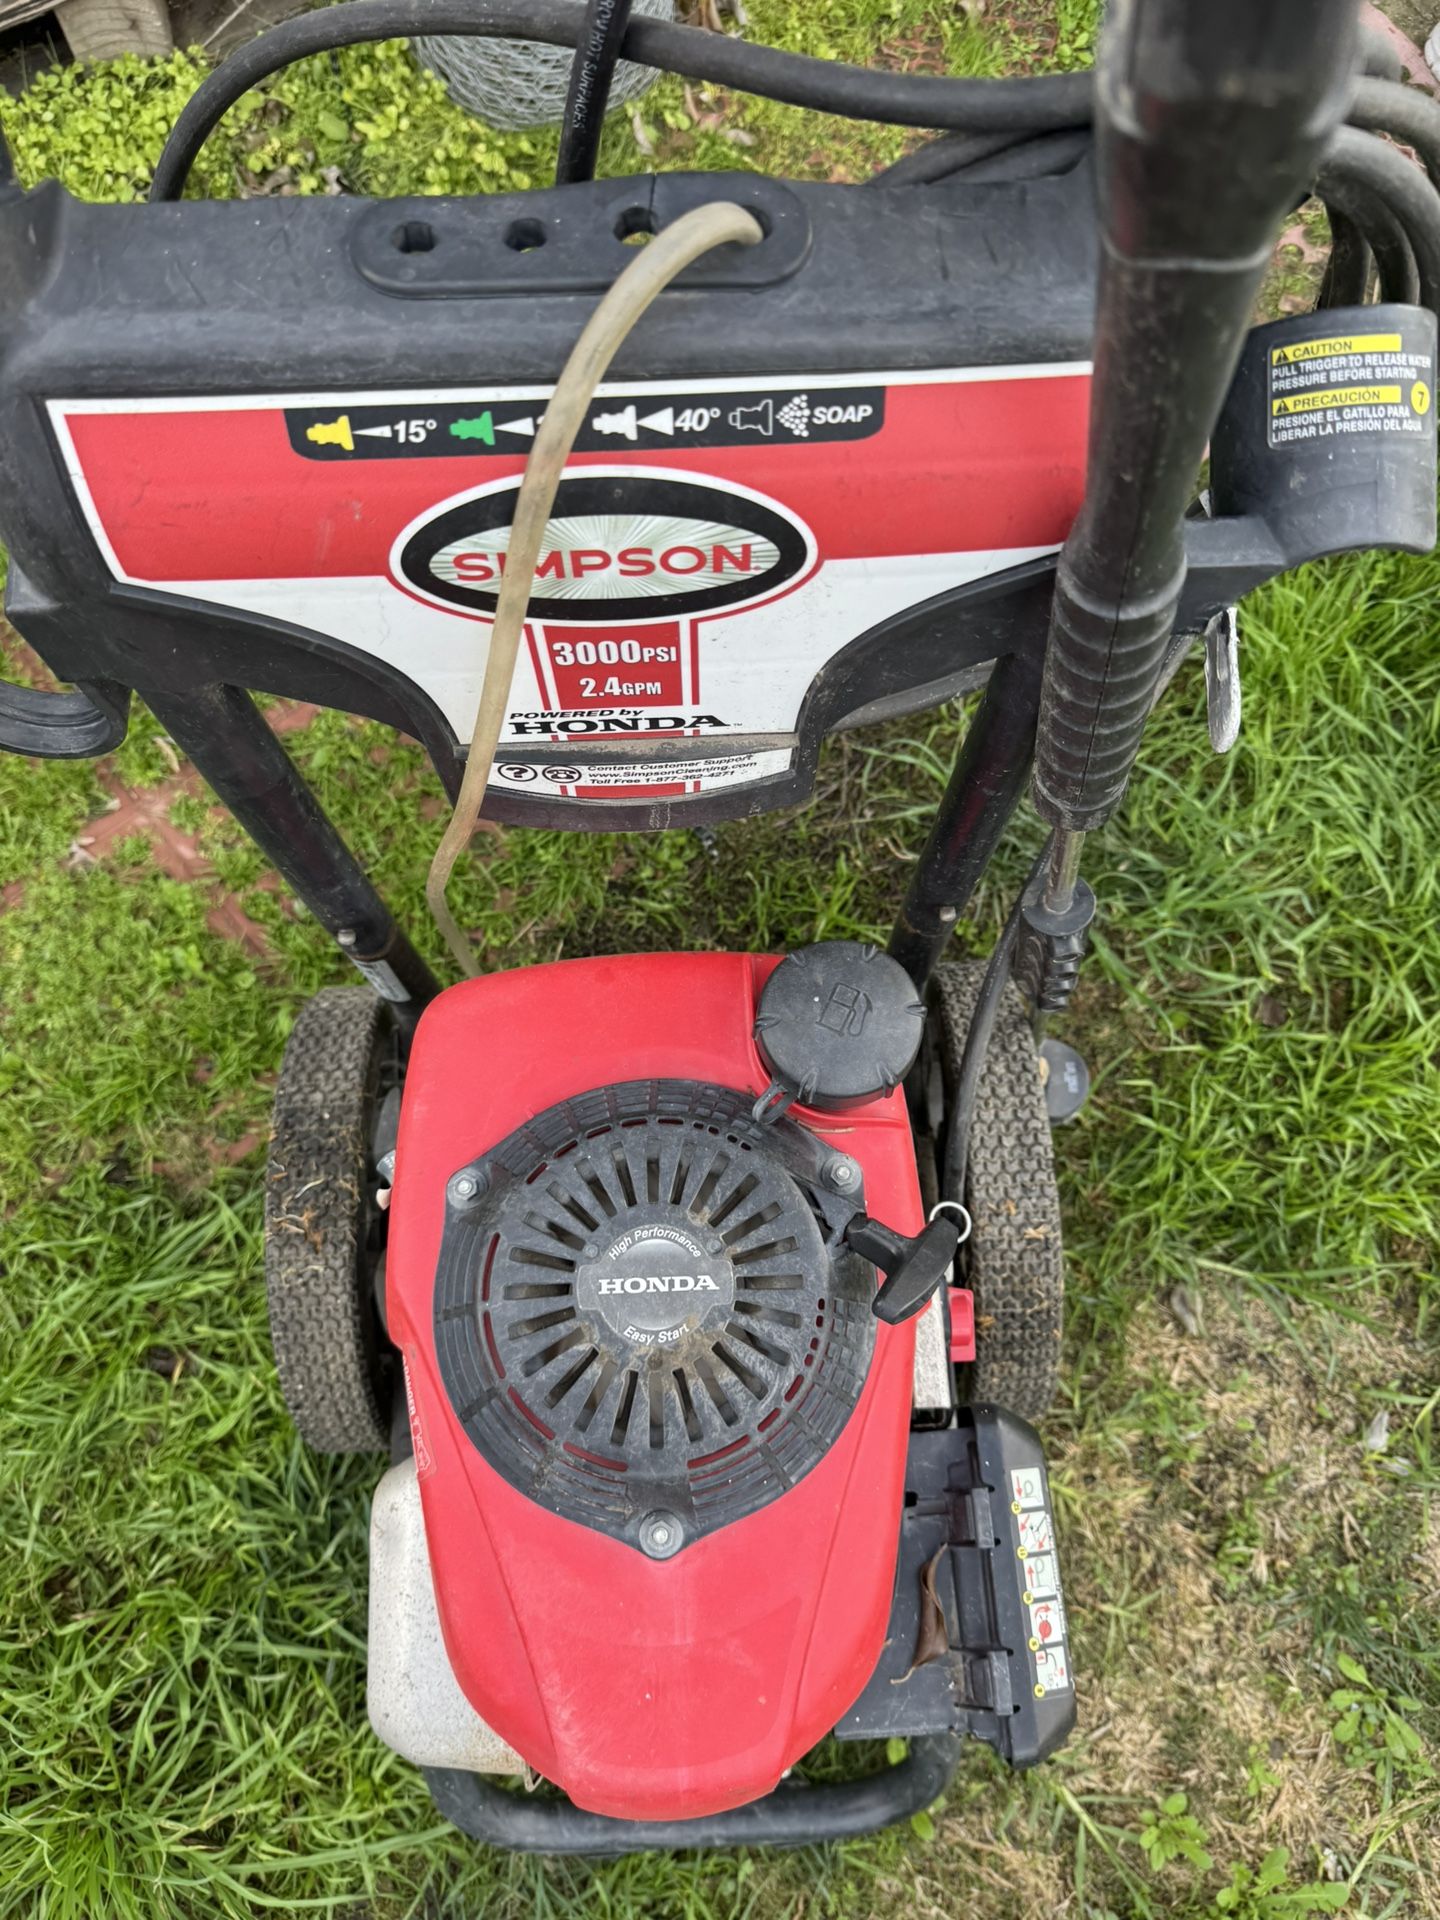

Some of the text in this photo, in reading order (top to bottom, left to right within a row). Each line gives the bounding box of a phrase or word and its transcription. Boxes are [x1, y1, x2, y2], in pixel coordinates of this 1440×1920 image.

[585, 30, 607, 60] HOT
[1292, 341, 1353, 359] CAUTION
[1272, 366, 1298, 380] PULL
[1299, 356, 1346, 373] TRIGGER
[1348, 354, 1363, 368] TO
[1365, 353, 1407, 367] RELEASE
[1272, 366, 1418, 392] PRESSURE BEFORE STARTING
[1292, 388, 1381, 410] PRECAUCIÓN
[1417, 391, 1426, 407] 7
[674, 407, 721, 432] 40°
[812, 405, 873, 425] SOAP
[1272, 404, 1411, 431] PRESIONE EL GATILLO PARA
[393, 419, 438, 444] 15°
[1272, 425, 1317, 443] LIBERAR
[1319, 423, 1334, 436] LA
[1335, 418, 1382, 434] PRESIÓN
[1383, 419, 1401, 432] DEL
[552, 639, 678, 667] 3000PSI
[578, 676, 662, 698] 2.4GPM
[507, 714, 732, 735] HONDA
[509, 708, 645, 720] POWERED by
[588, 761, 758, 778] www.SimpsonCleaning.com
[640, 761, 701, 770] Customer
[703, 753, 754, 766] Support
[608, 1226, 702, 1260] High Performance
[598, 1275, 720, 1295] HONDA
[623, 1323, 690, 1346] Easy Start
